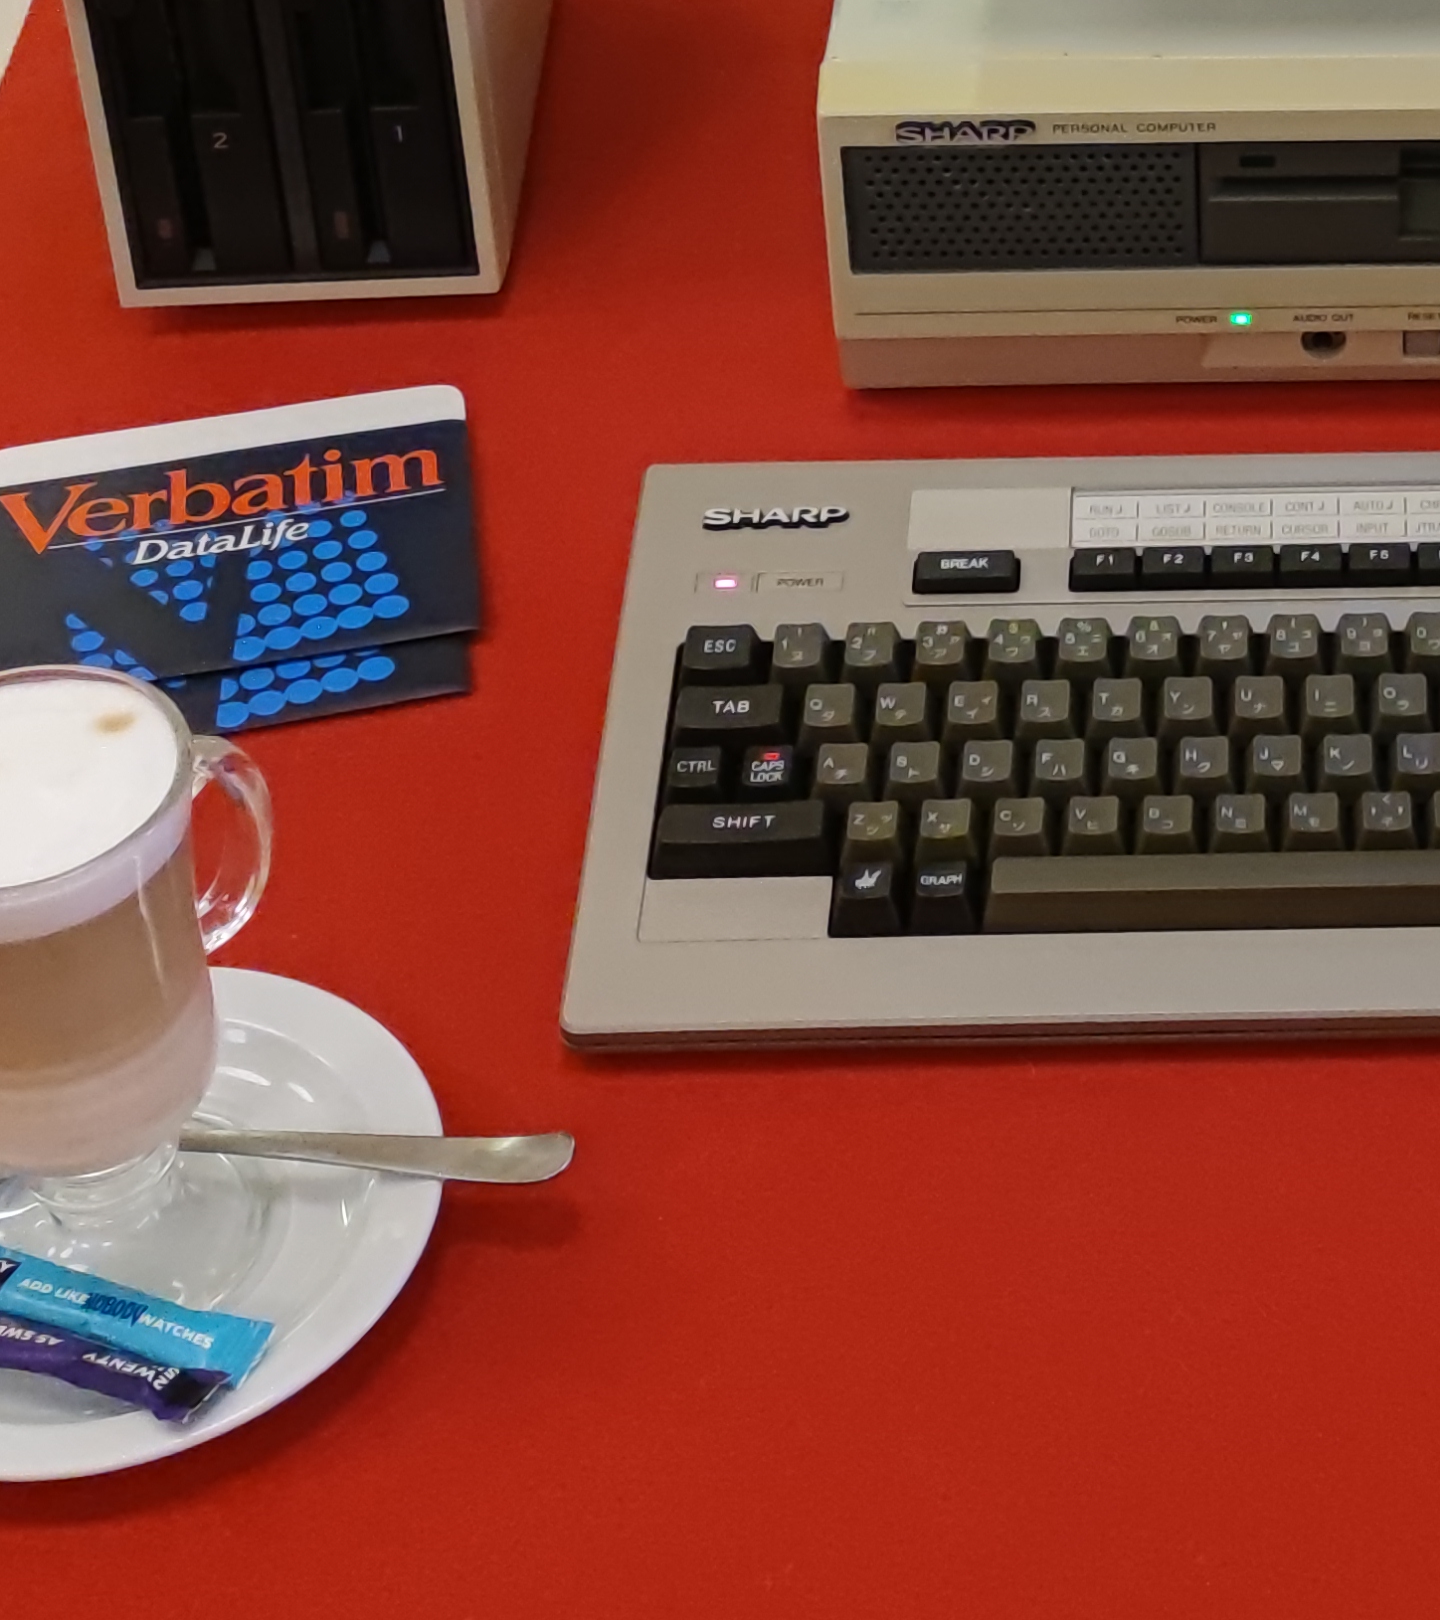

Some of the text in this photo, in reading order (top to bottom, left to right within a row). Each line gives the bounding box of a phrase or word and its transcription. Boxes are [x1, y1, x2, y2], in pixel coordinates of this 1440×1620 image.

[396, 126, 405, 142] 1
[896, 120, 1036, 144] SHARP
[1052, 122, 1217, 135] PERSONAL COMPUTER
[213, 133, 228, 149] 2
[702, 505, 851, 532] SHARP
[131, 518, 316, 566] DataLife
[940, 556, 990, 570] BREAK
[1163, 553, 1183, 565] F2
[1234, 552, 1254, 564] F3
[1300, 550, 1320, 562] F4
[703, 639, 736, 653] ESC
[712, 700, 750, 714] TAB
[676, 760, 716, 773] CTRL
[751, 760, 785, 771] CAPS
[712, 815, 776, 828] SHIFT
[17, 1278, 53, 1294] ADD
[54, 1288, 91, 1305] LIKE
[139, 1313, 215, 1349] WATCHES
[82, 1352, 170, 1390] 2WENTY
